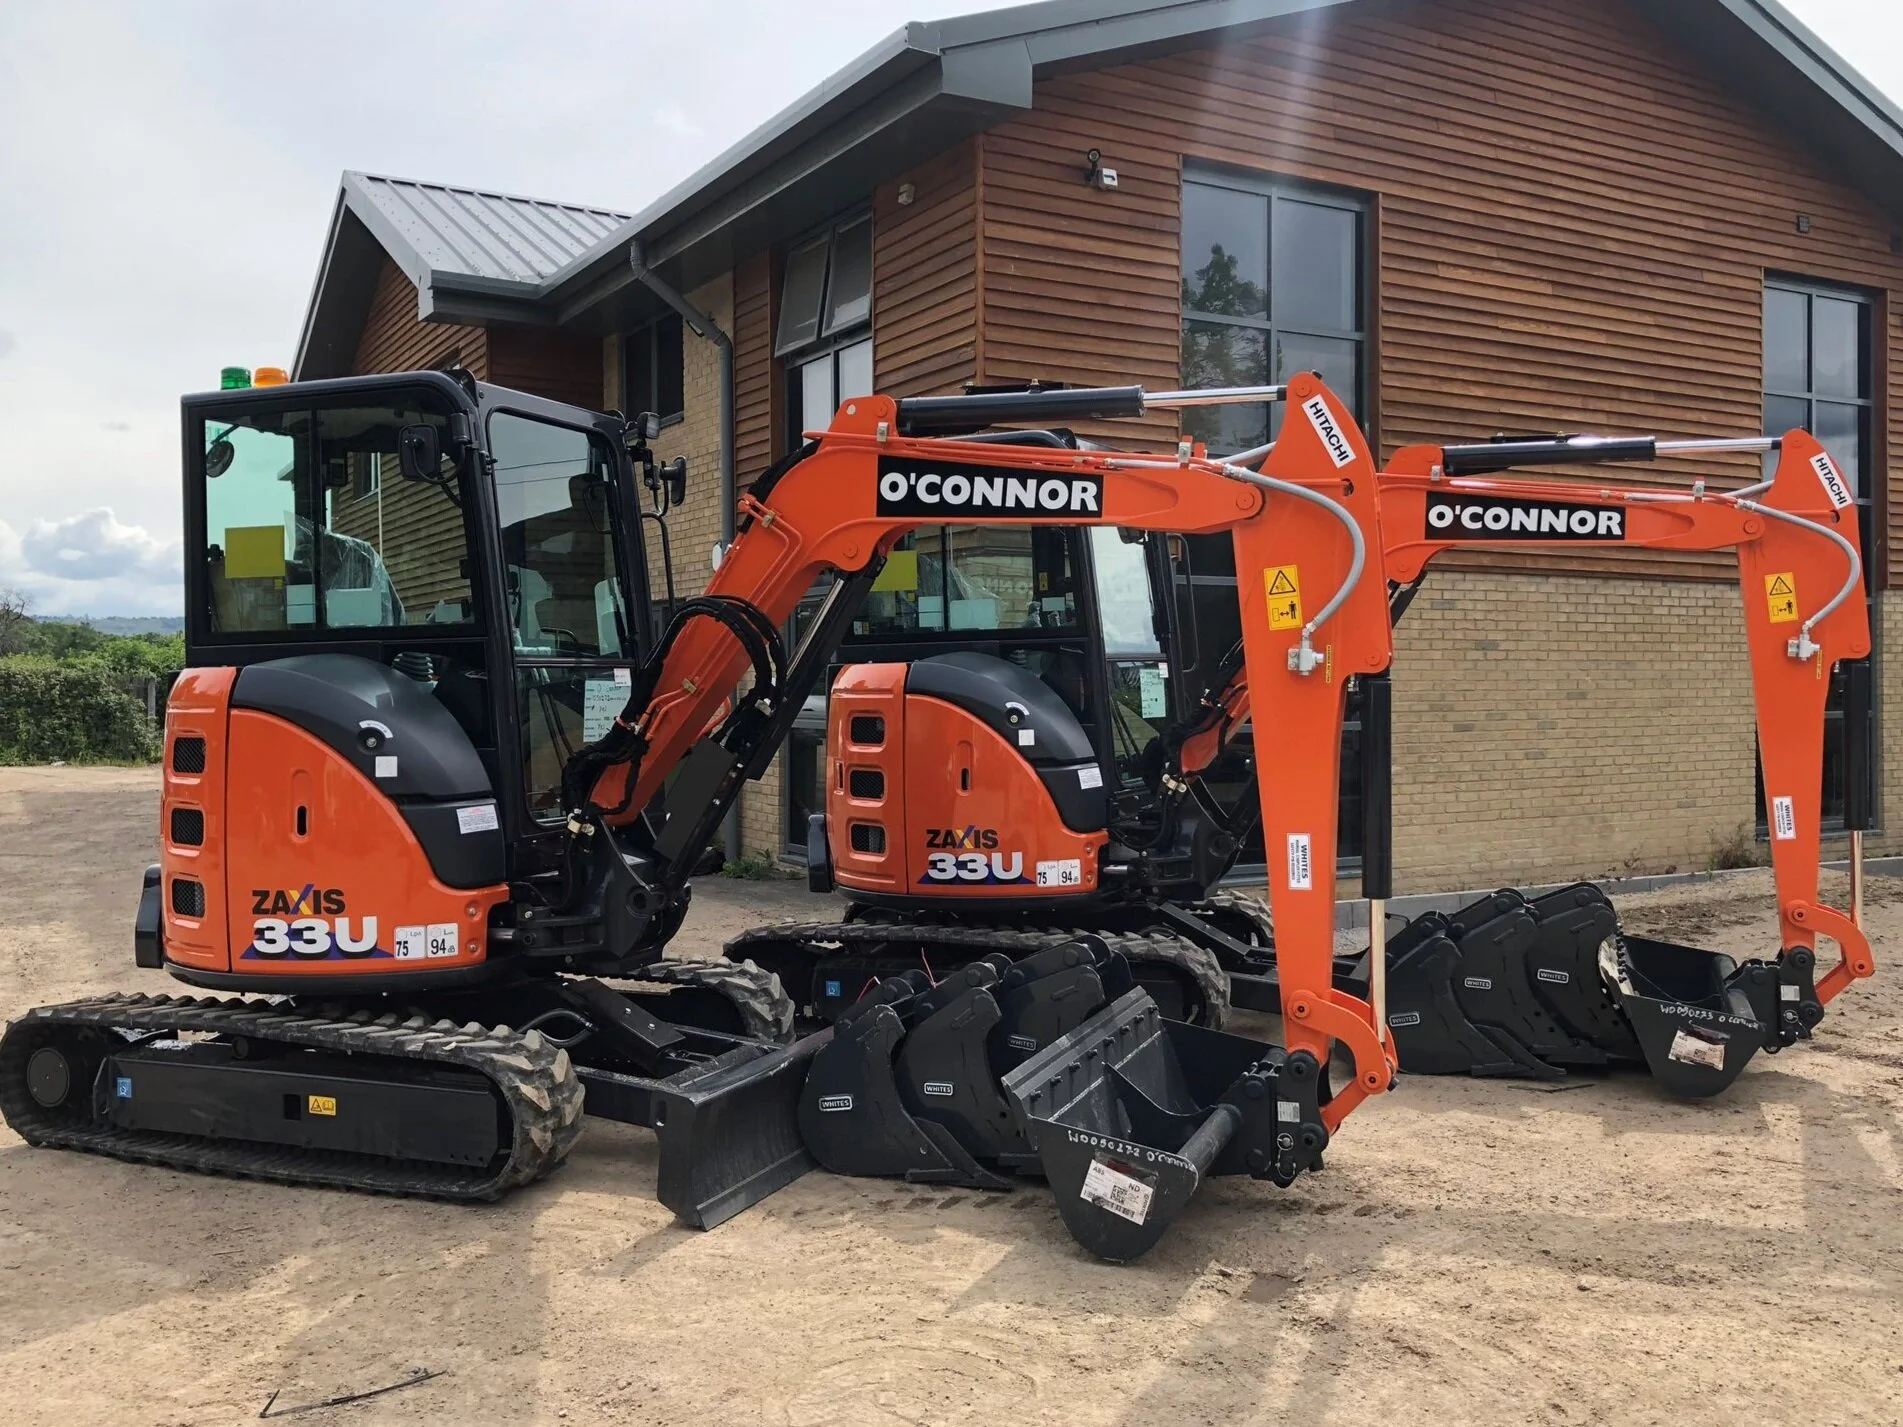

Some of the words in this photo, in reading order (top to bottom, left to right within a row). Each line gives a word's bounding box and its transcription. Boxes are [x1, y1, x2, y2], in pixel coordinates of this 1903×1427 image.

[1309, 401, 1350, 462] HITACHI
[1816, 457, 1848, 505] HITACHI
[879, 472, 1098, 512] O'CONNOR
[1428, 504, 1622, 536] O'CONNOR
[926, 825, 999, 849] ZAXIS
[927, 852, 1023, 881] 33U
[1301, 844, 1309, 879] WHITES
[1038, 872, 1047, 884] 75
[1061, 871, 1072, 883] 94
[252, 884, 346, 915] ZAXIS
[253, 916, 377, 954] 33U
[396, 940, 409, 957] 75
[431, 938, 446, 955] 94
[1466, 980, 1490, 988] WHITES
[1540, 972, 1567, 981] WHITES
[1391, 1015, 1417, 1024] WHITES
[1010, 1038, 1034, 1049] WHITES
[926, 1085, 951, 1093] WHITES
[822, 1099, 850, 1108] WHITES
[1093, 1165, 1105, 1175] ABS
[1128, 1183, 1140, 1192] ND
